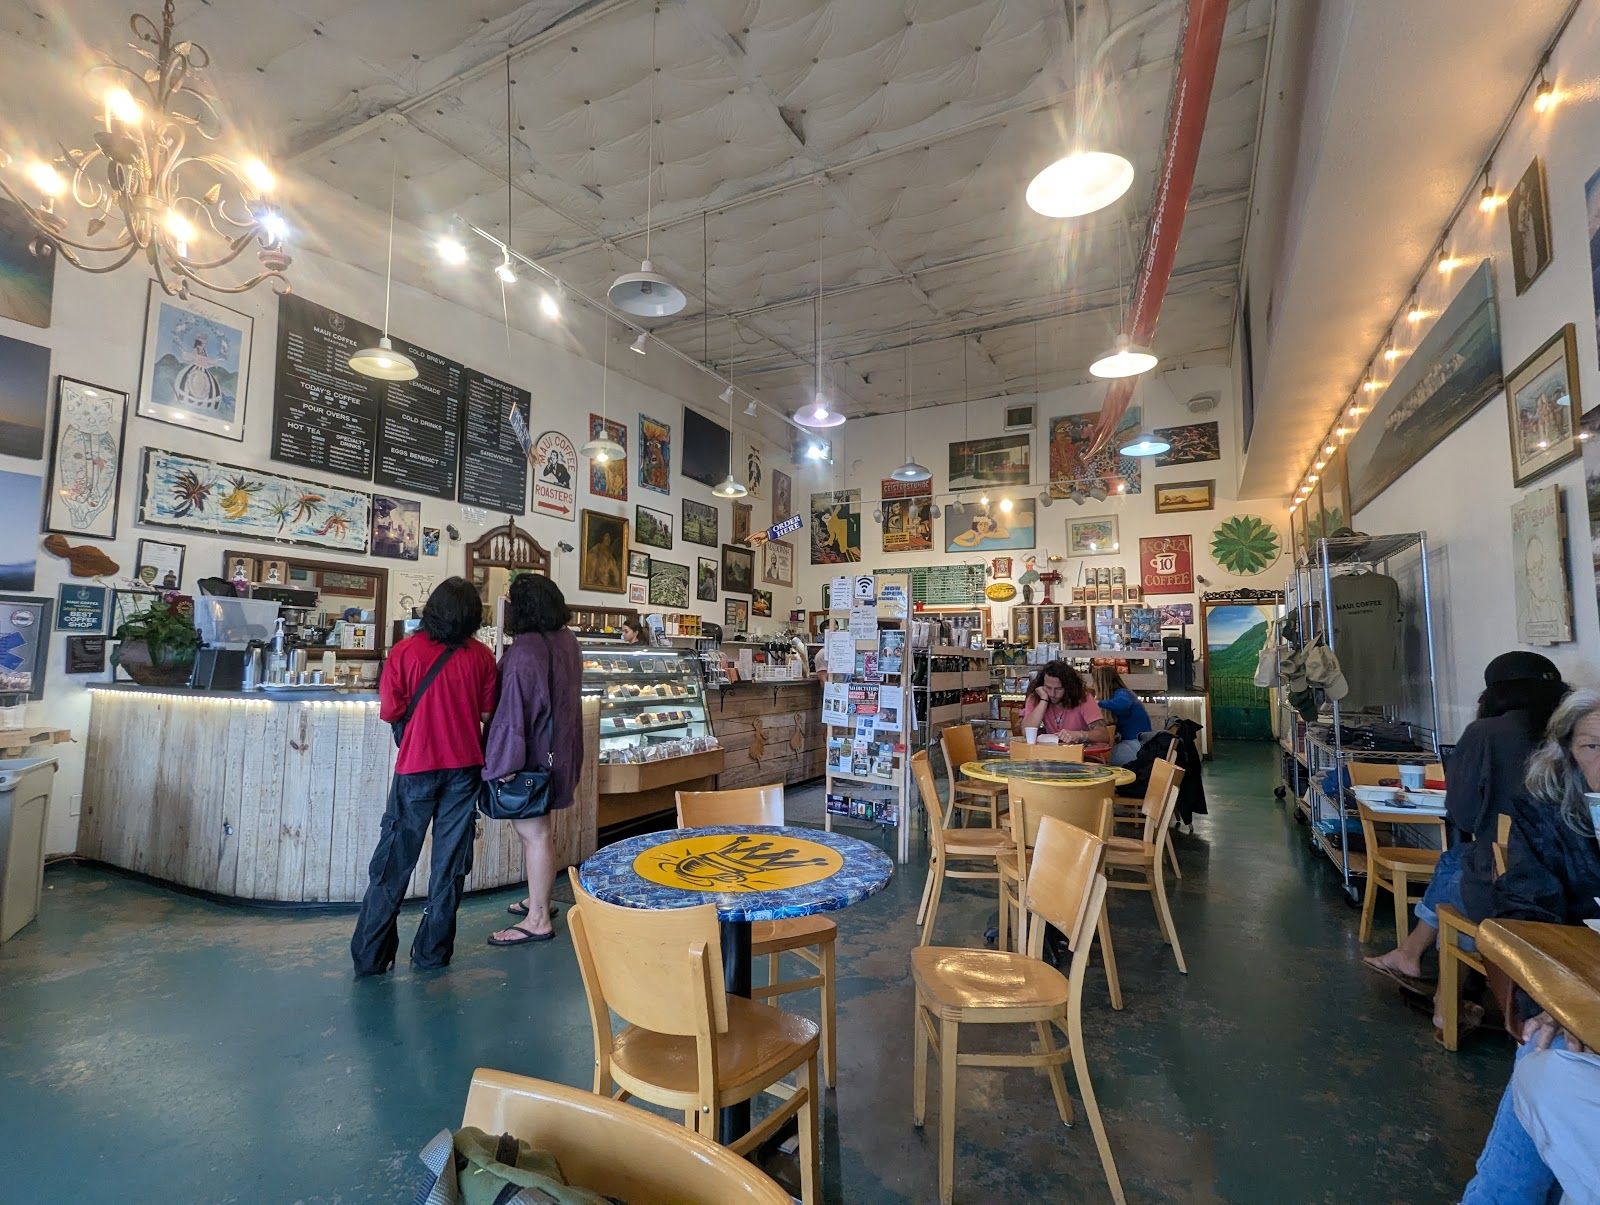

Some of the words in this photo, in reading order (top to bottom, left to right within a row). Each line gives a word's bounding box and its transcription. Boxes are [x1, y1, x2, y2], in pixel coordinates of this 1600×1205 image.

[313, 326, 331, 337] MAUI
[332, 333, 358, 347] COFFEE
[408, 347, 425, 358] COLD
[426, 353, 446, 366] BREW
[409, 380, 441, 396] LEMONADE
[483, 377, 513, 392] BREAKFAST
[300, 381, 331, 396] TODAY'S
[333, 390, 361, 405] COFFEE
[302, 403, 324, 414] POUR
[326, 410, 351, 422] OVERS
[287, 421, 304, 431] HOT
[306, 426, 321, 435] TEA
[401, 414, 419, 424] COLD
[420, 419, 443, 431] DRINKS
[335, 434, 366, 446] SPECIALTY
[340, 440, 362, 450] DRINKS
[390, 447, 408, 457] EGGS
[409, 452, 440, 465] BENEDICT
[480, 449, 514, 463] SANDWICHES
[539, 436, 553, 466] MAUI
[554, 436, 576, 473] COFFEE
[535, 484, 573, 504] ROASTERS
[772, 515, 801, 532] ORDER
[776, 522, 800, 537] HERE
[1142, 539, 1188, 552] KONA
[1144, 572, 1190, 587] COFFEE
[1355, 600, 1382, 608] COFFEE
